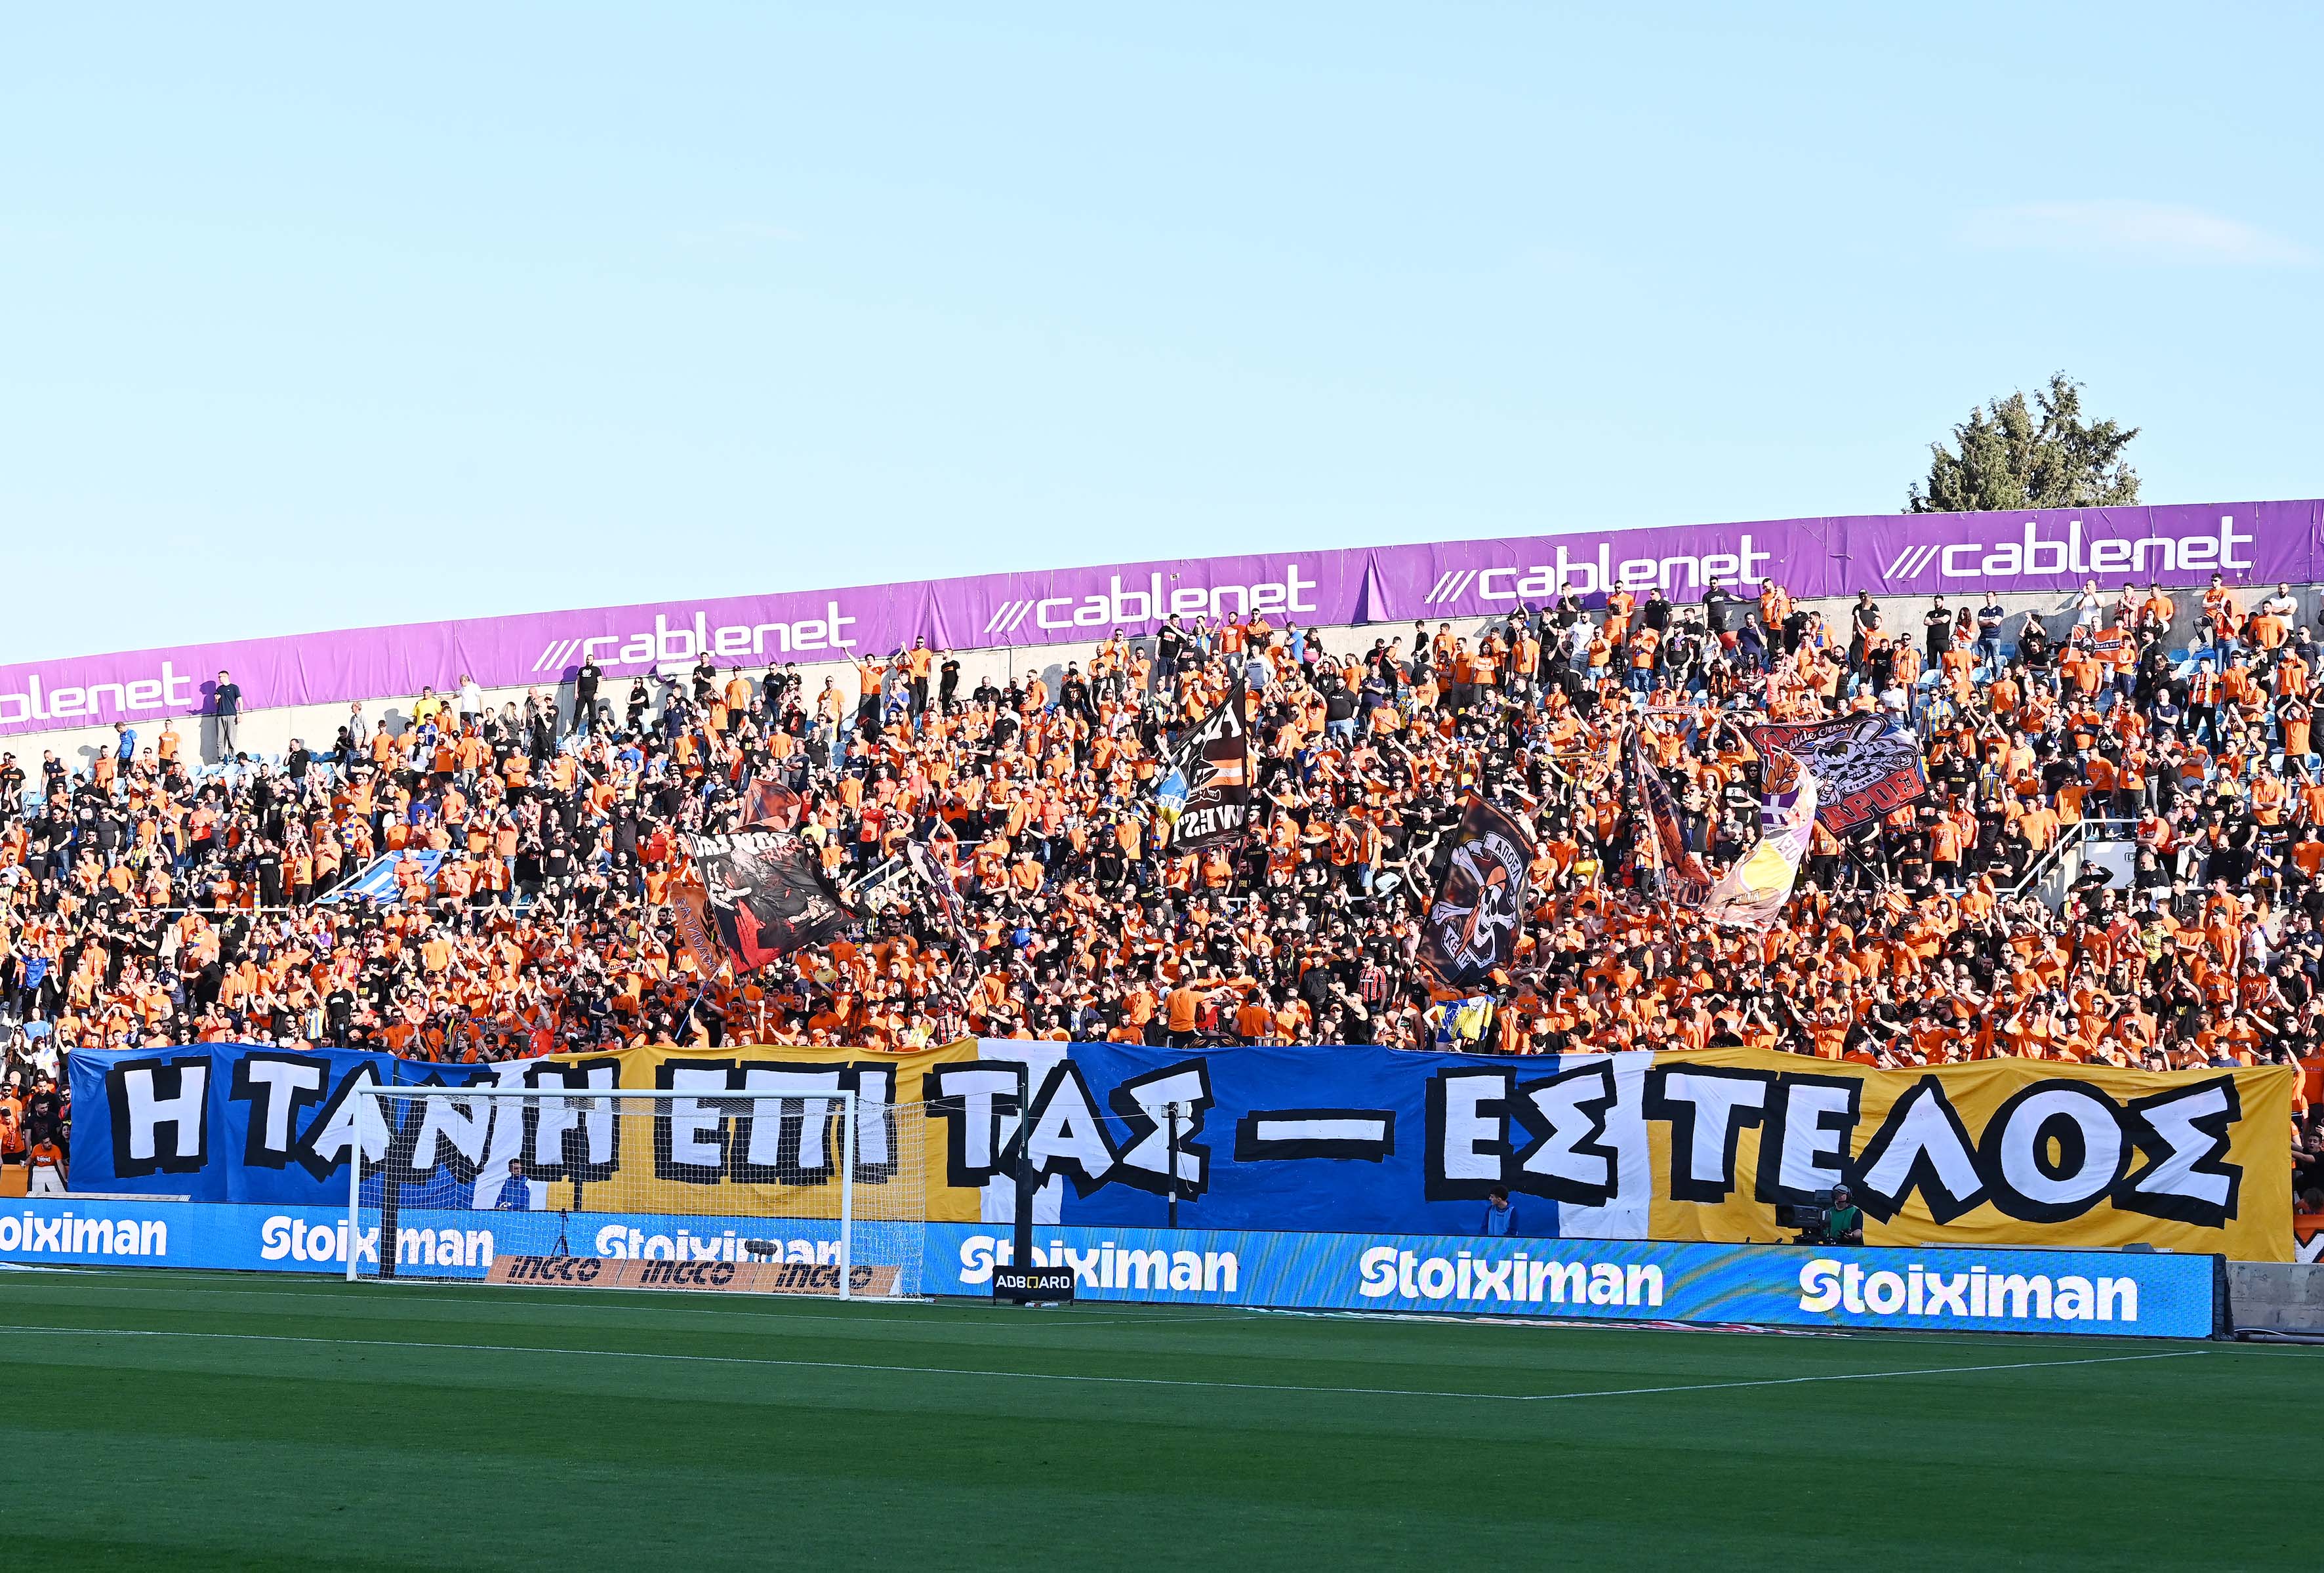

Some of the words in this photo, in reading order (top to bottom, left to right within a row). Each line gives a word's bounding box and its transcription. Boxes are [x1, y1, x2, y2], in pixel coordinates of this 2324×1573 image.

[1478, 534, 1770, 600] cablenet
[1942, 516, 2253, 577] cablenet
[1036, 564, 1316, 630] cablenet
[583, 601, 856, 666] cablenet
[1789, 729, 1817, 750] side
[1821, 767, 1925, 830] APOEL
[1848, 770, 1884, 790] ULTRAS
[1495, 840, 1519, 880] ΑΠΟΕΛ
[113, 1060, 209, 1168] Η
[661, 1063, 893, 1177] ΕΠΙ
[931, 1063, 1209, 1193] ΤΑΣ
[1654, 1068, 2236, 1219] ΤΕΛΟΣ
[261, 1216, 493, 1267] Stoixman
[960, 1236, 1237, 1292] Stiximan
[1359, 1246, 1663, 1306] Stoiximan
[1799, 1259, 2138, 1322] Stoiximan
